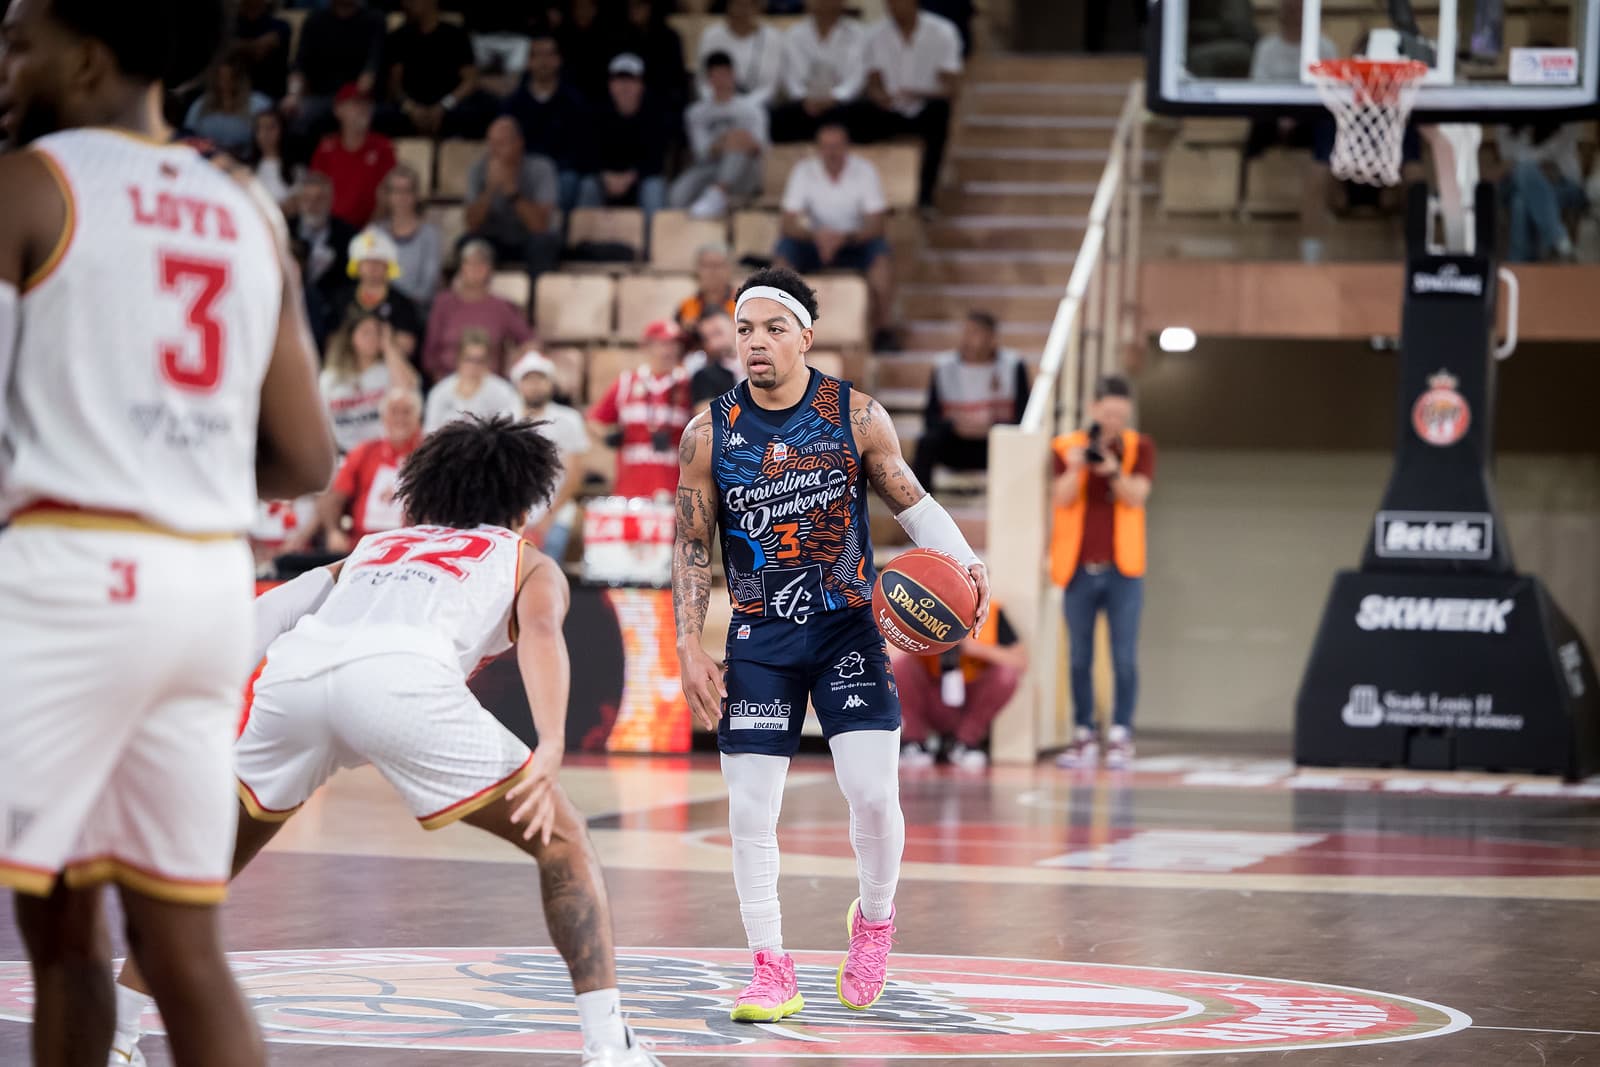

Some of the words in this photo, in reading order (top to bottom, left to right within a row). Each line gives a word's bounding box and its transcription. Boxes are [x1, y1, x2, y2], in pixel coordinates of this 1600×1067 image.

[161, 254, 228, 391] 3
[801, 446, 813, 454] LYS
[726, 470, 822, 511] Gravelines
[740, 484, 847, 538] Dunkerque
[352, 535, 496, 582] 32
[773, 522, 801, 559] 3
[109, 560, 137, 604] 3
[880, 608, 930, 650] LEGACY
[888, 583, 951, 640] SPALDING
[1355, 595, 1515, 633] SKWEEK
[831, 681, 876, 692] Hauts-de-France
[729, 699, 791, 717] clovis
